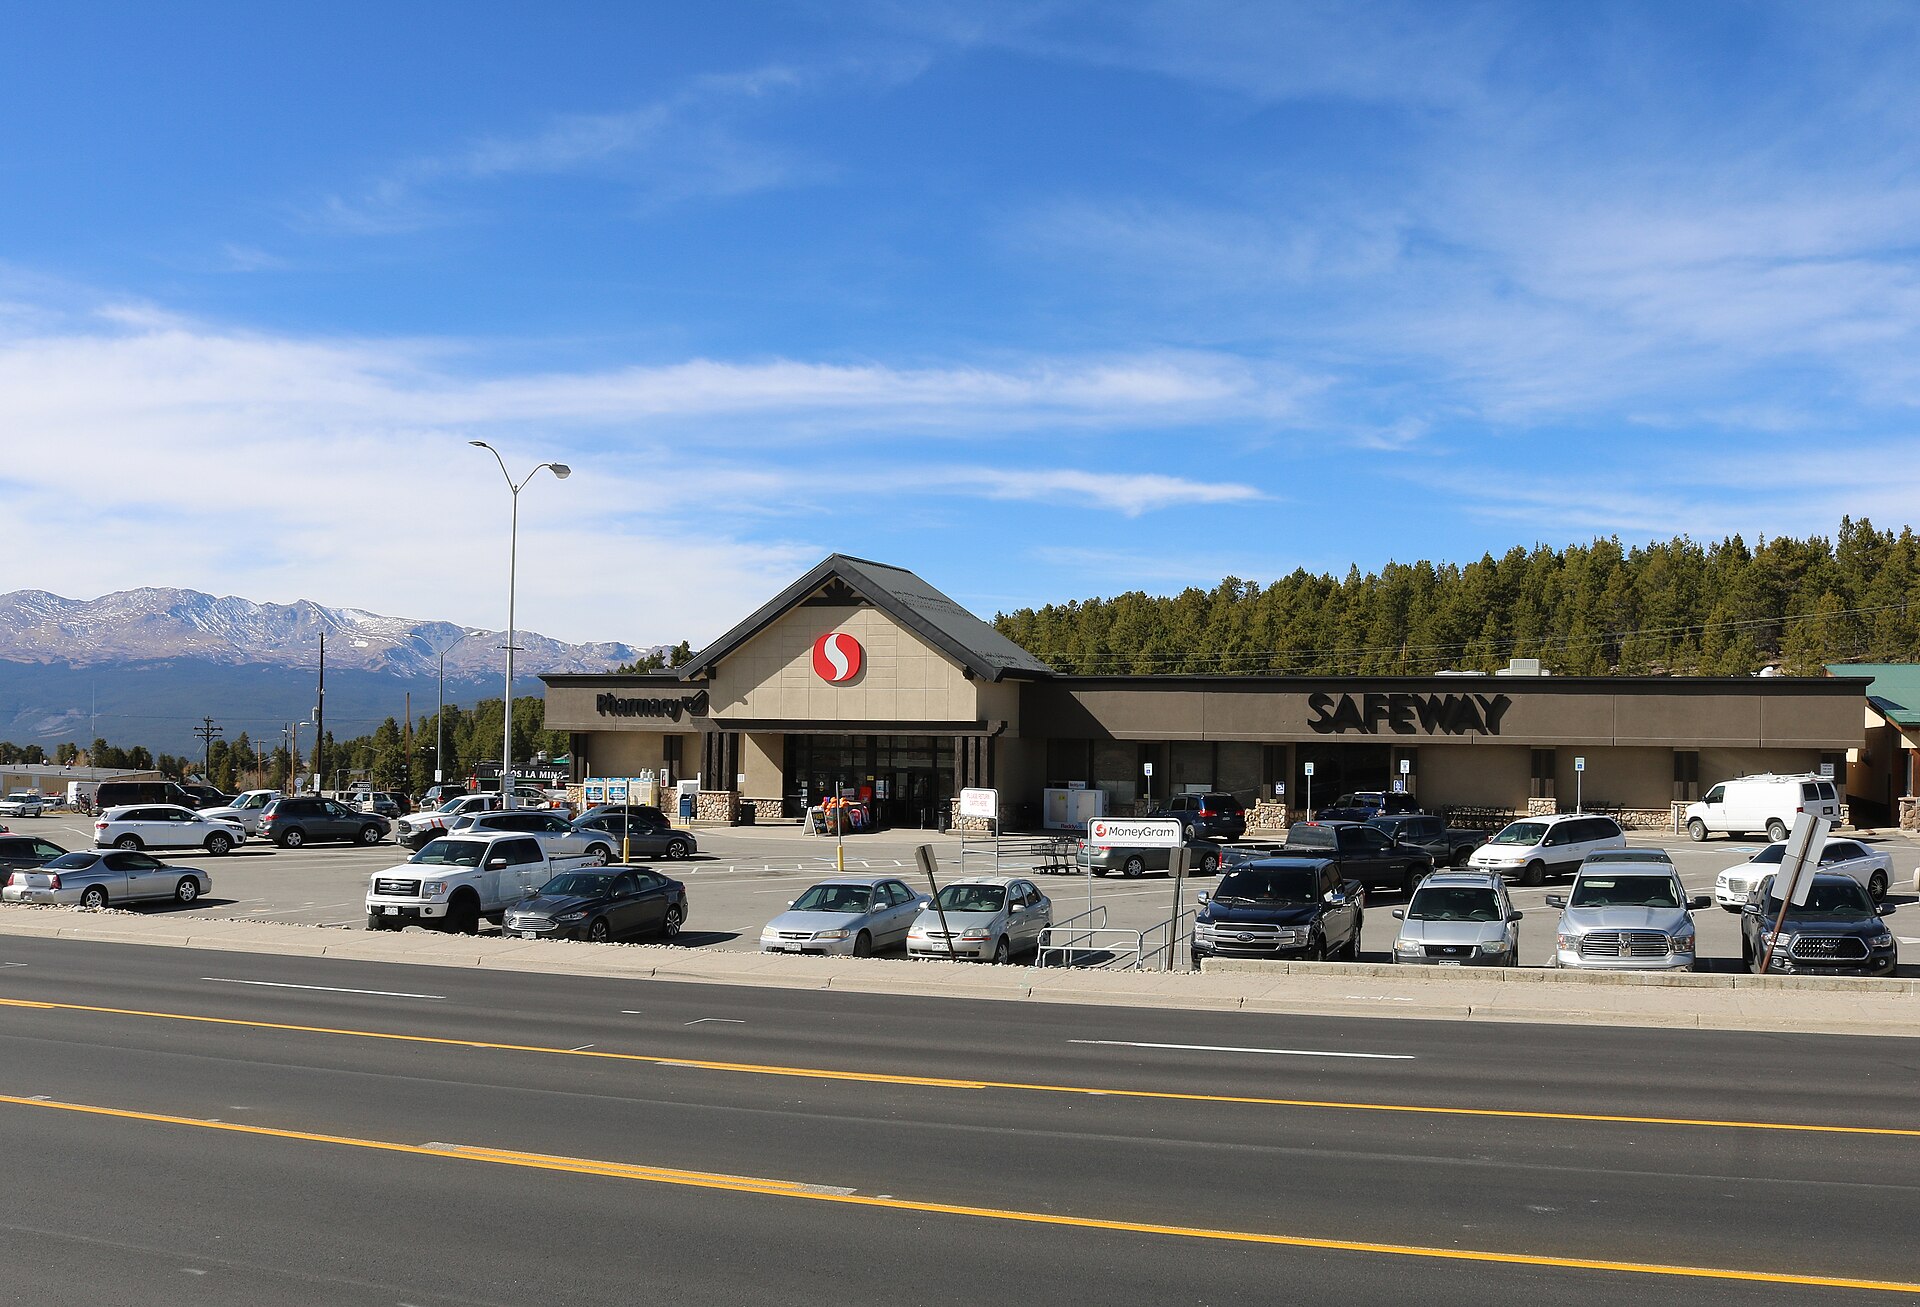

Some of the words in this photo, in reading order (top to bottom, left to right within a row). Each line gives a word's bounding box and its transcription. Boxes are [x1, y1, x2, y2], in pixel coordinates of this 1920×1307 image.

[597, 693, 682, 722] Pharmacy
[1307, 692, 1512, 735] SAFEWAY
[525, 770, 536, 778] LA
[1109, 827, 1174, 838] MoneyGram
